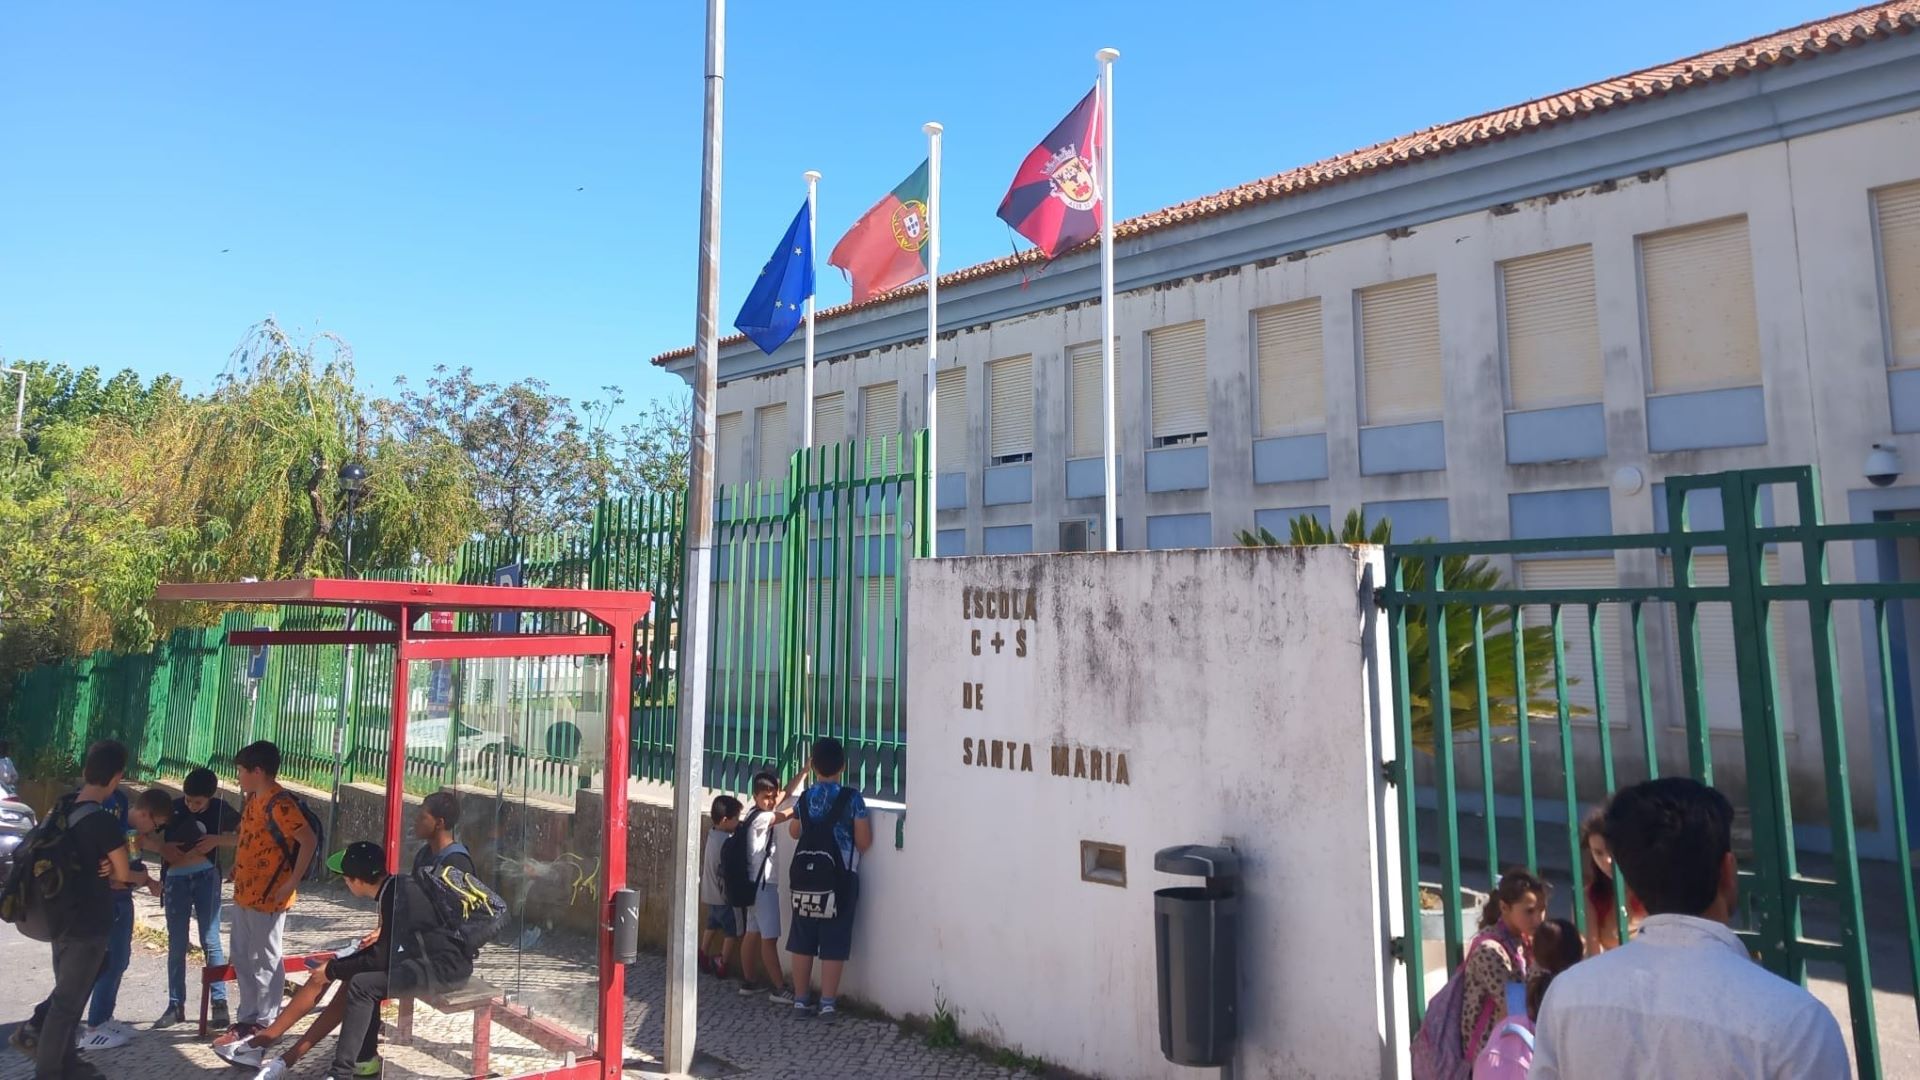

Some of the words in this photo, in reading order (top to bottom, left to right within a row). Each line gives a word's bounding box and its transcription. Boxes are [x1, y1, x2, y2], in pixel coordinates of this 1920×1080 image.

[963, 588, 1037, 620] ESCOLA
[971, 629, 981, 656] C
[990, 631, 1005, 654] +
[1016, 629, 1027, 657] S
[963, 682, 984, 710] DE
[963, 737, 1033, 772] SANTA
[1051, 744, 1130, 785] MARIA
